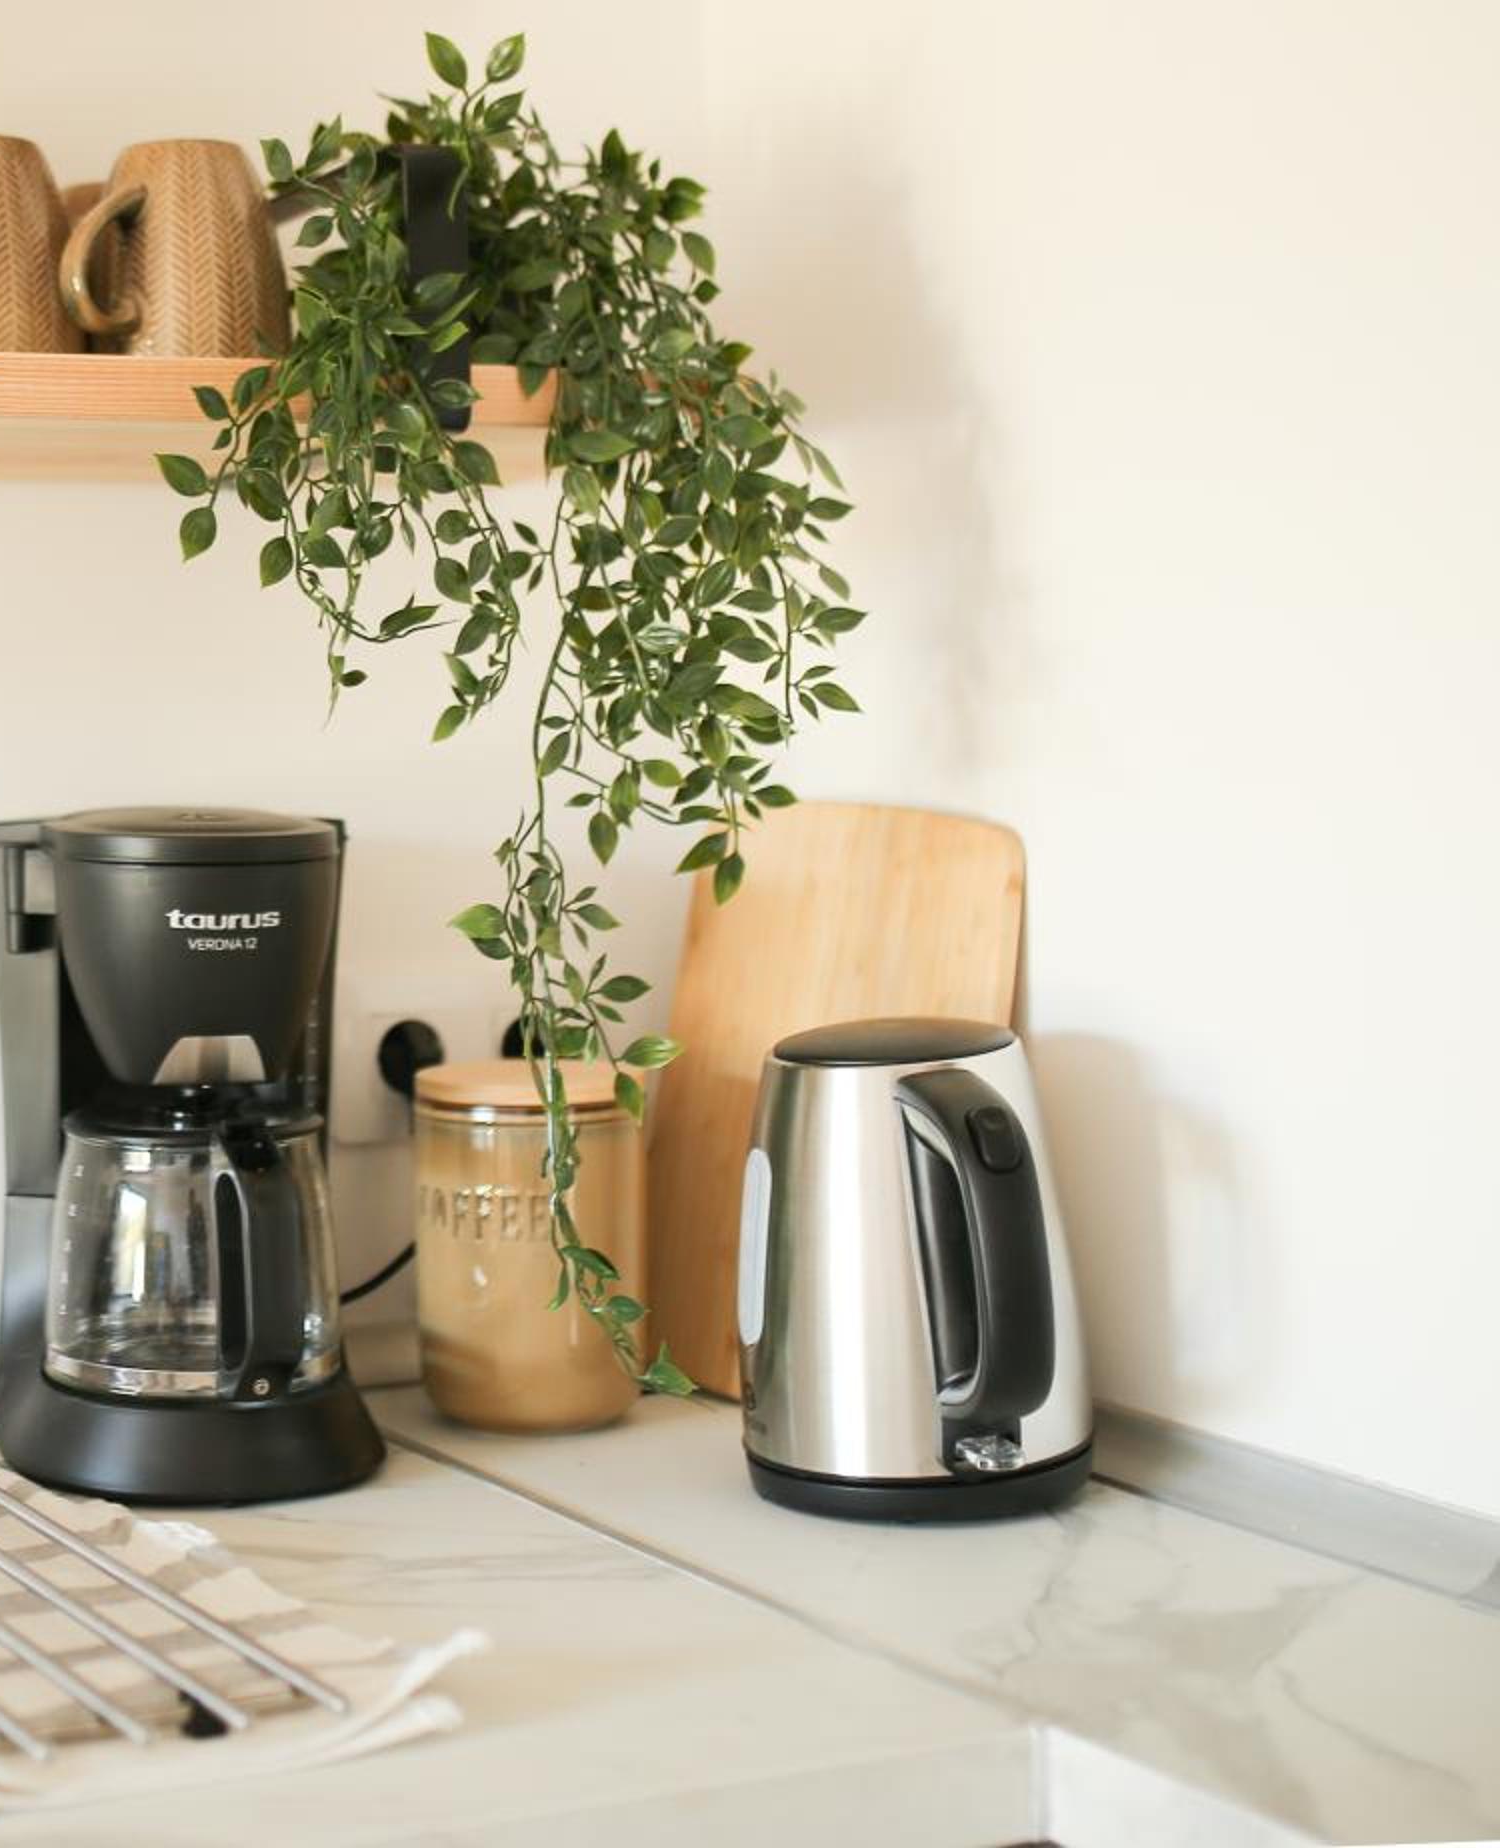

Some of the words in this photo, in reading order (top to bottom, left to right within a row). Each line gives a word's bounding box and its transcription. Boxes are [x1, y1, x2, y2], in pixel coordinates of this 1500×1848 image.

[165, 909, 280, 930] taurus
[187, 938, 242, 951] VERONA
[244, 937, 258, 950] 12
